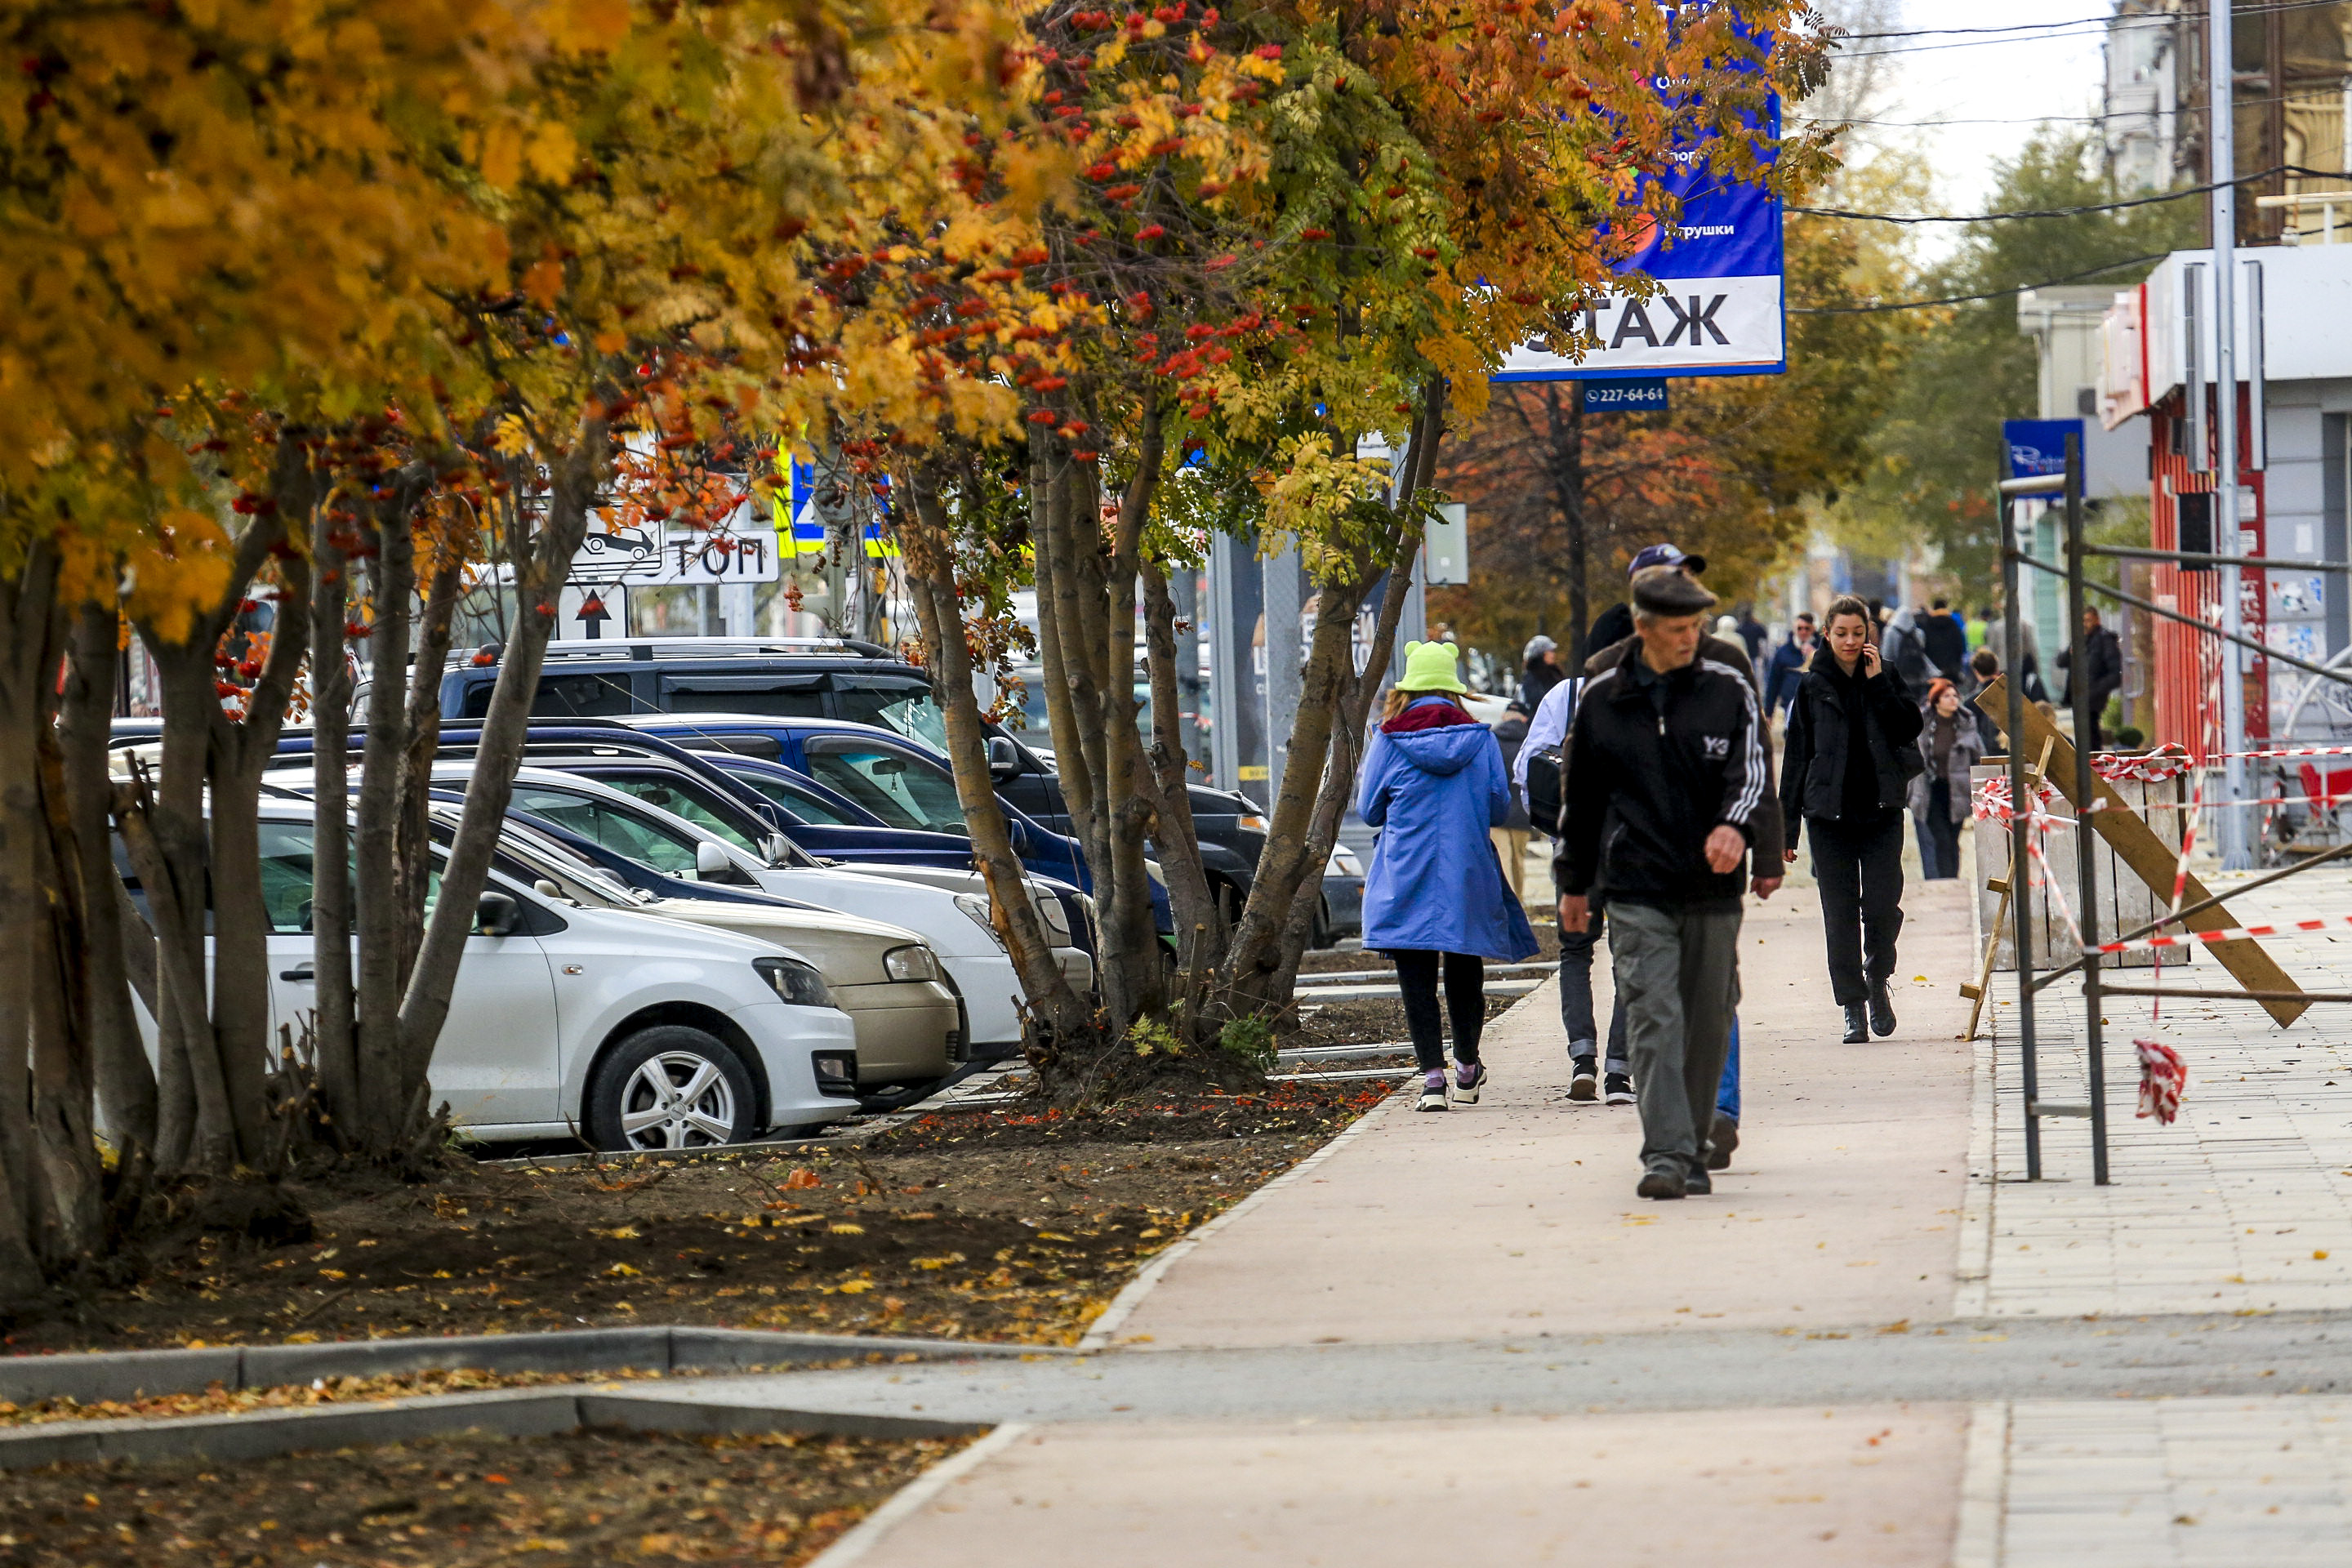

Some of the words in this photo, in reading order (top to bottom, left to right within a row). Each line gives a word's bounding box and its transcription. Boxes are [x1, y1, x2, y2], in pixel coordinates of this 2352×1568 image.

[1526, 294, 1731, 352] ТАЖ
[1601, 388, 1664, 402] 227-64-64
[644, 539, 764, 577] ТОП
